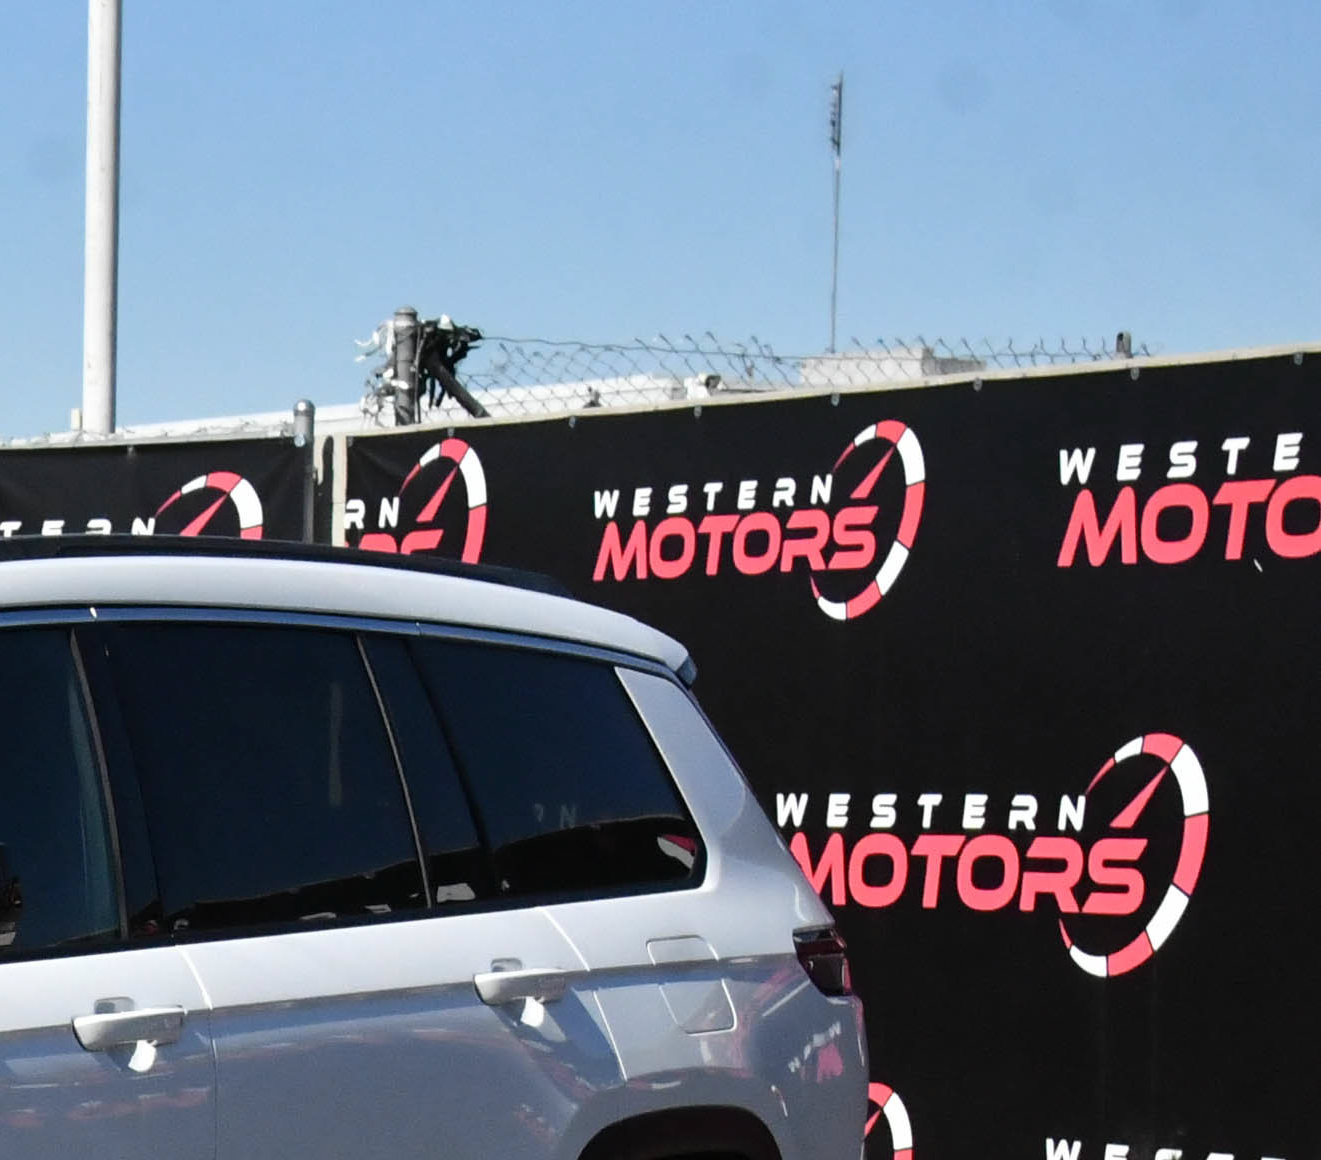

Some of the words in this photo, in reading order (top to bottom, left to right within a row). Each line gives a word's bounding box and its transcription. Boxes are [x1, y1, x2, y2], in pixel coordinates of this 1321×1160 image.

[594, 474, 833, 519] WESTERN
[592, 505, 880, 583] MOTORS
[776, 792, 1087, 832] WESTERN
